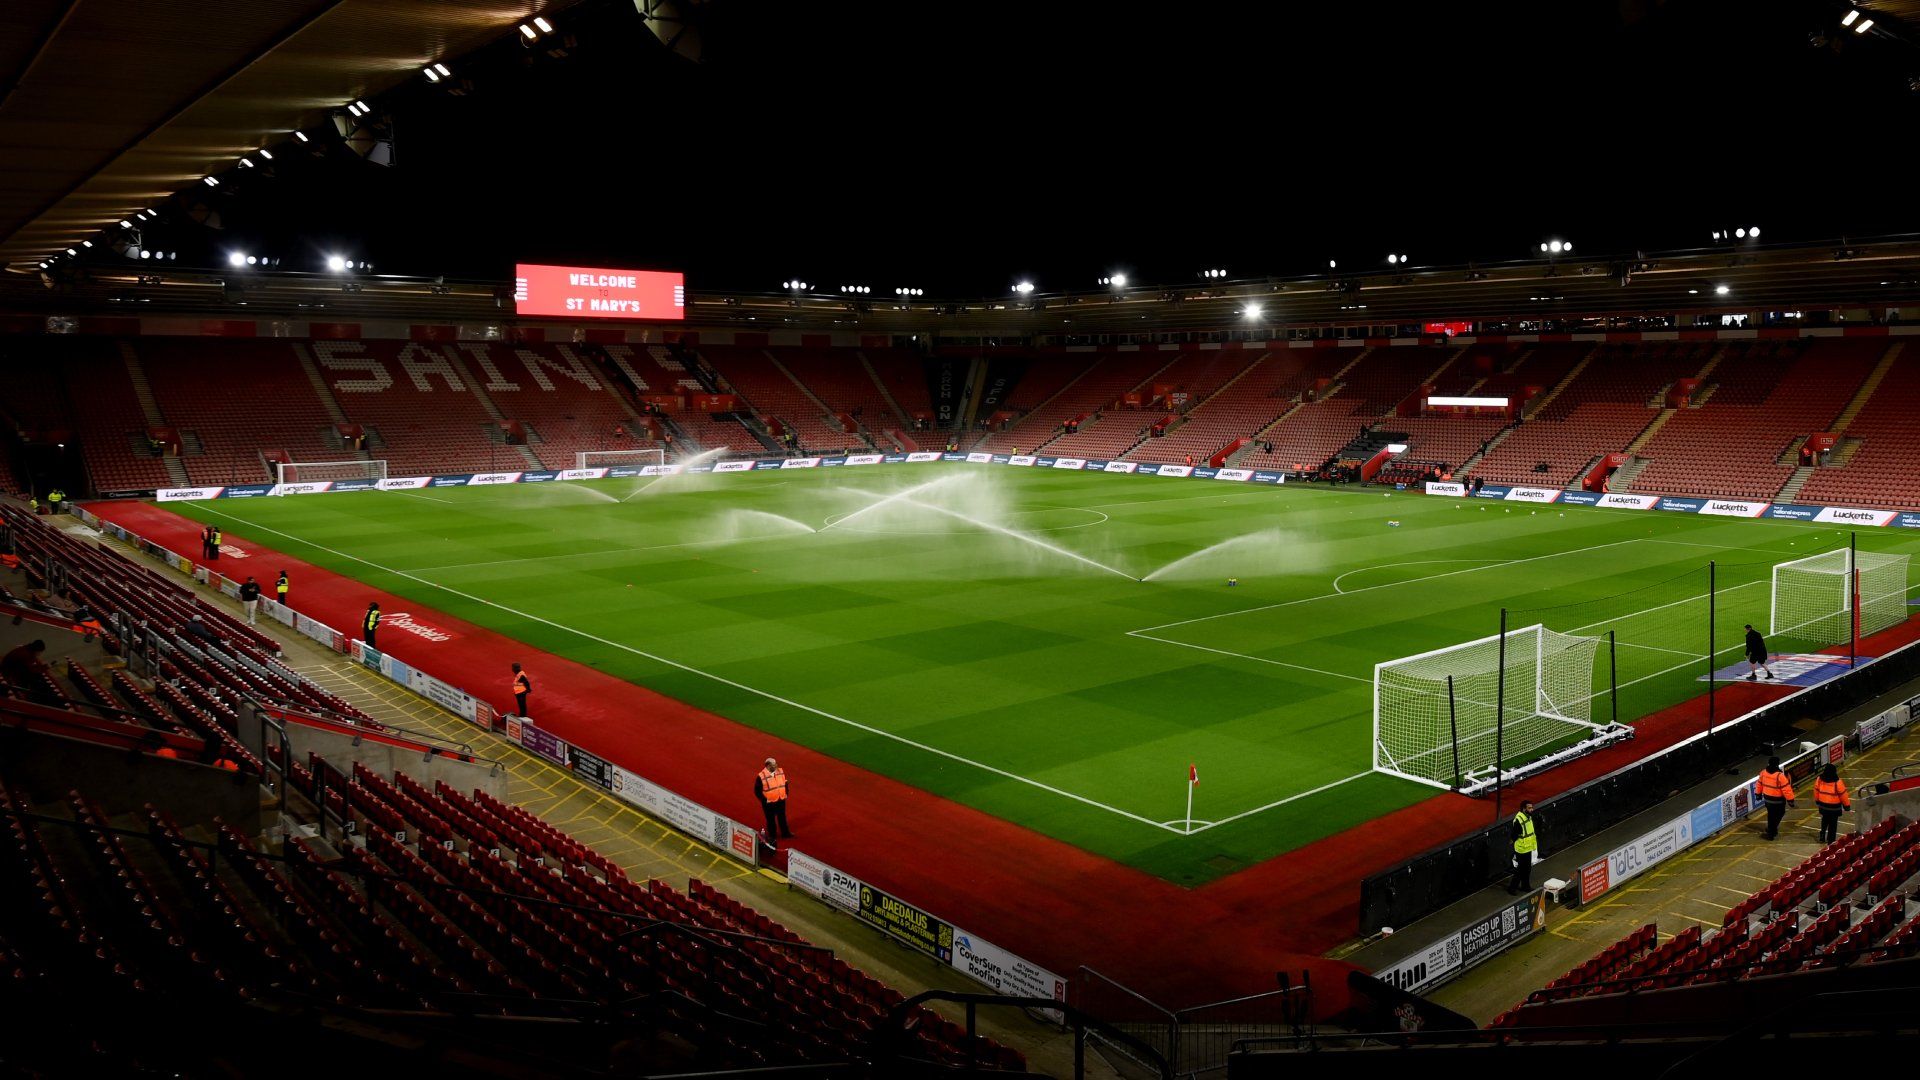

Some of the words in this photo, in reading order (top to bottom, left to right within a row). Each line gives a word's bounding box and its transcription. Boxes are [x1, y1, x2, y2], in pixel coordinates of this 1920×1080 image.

[569, 273, 637, 289] WELCOME
[566, 298, 584, 311] ST
[590, 299, 640, 312] MARY'S
[1608, 496, 1641, 504] Lucketts
[1712, 502, 1748, 512] Lucketts
[1833, 510, 1874, 521] Lucketts
[832, 873, 857, 892] RPM
[882, 896, 928, 929] DAEDALUS
[1463, 922, 1490, 945] GASSED
[1490, 916, 1500, 931] UP
[1463, 934, 1489, 956] HEATING
[1489, 929, 1501, 943] LTD
[959, 947, 1002, 976] CoverSure
[969, 963, 1001, 988] Roofing
[1378, 962, 1427, 992] ilan
